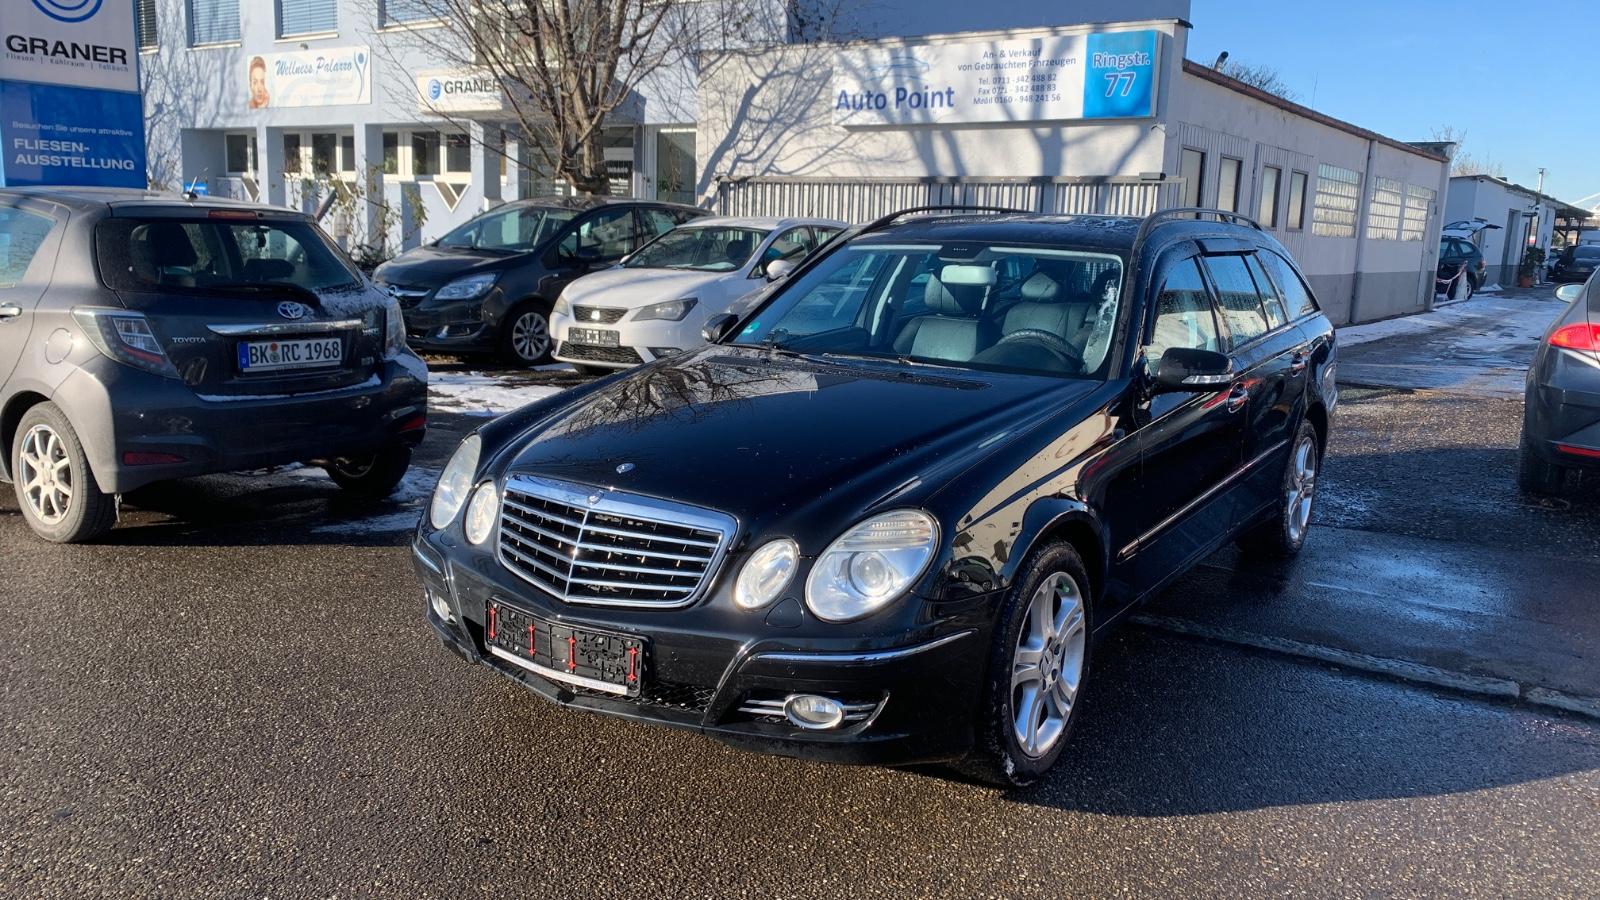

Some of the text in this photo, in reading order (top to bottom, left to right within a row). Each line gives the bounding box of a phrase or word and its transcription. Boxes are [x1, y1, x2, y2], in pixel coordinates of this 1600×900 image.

[5, 34, 128, 65] GRANER
[983, 47, 1041, 59] An- & Verkauf
[275, 56, 352, 76] Wellness Palazzo
[975, 61, 1027, 71] Gebrauchten
[1092, 51, 1151, 70] Ringstr.
[979, 77, 991, 85] Tel.
[1104, 72, 1136, 97] 77
[836, 85, 955, 111] Auto Point
[978, 87, 990, 95] Fax
[1051, 93, 1061, 102] 56
[12, 121, 133, 137] Besuchen Sie unsere attraktive
[14, 138, 90, 153] FLIESEN-
[15, 153, 135, 170] AUSSTELLUNG
[171, 336, 206, 345] TOYOTA
[249, 344, 270, 365] BK
[281, 343, 301, 363] RC
[304, 341, 341, 361] 1968
